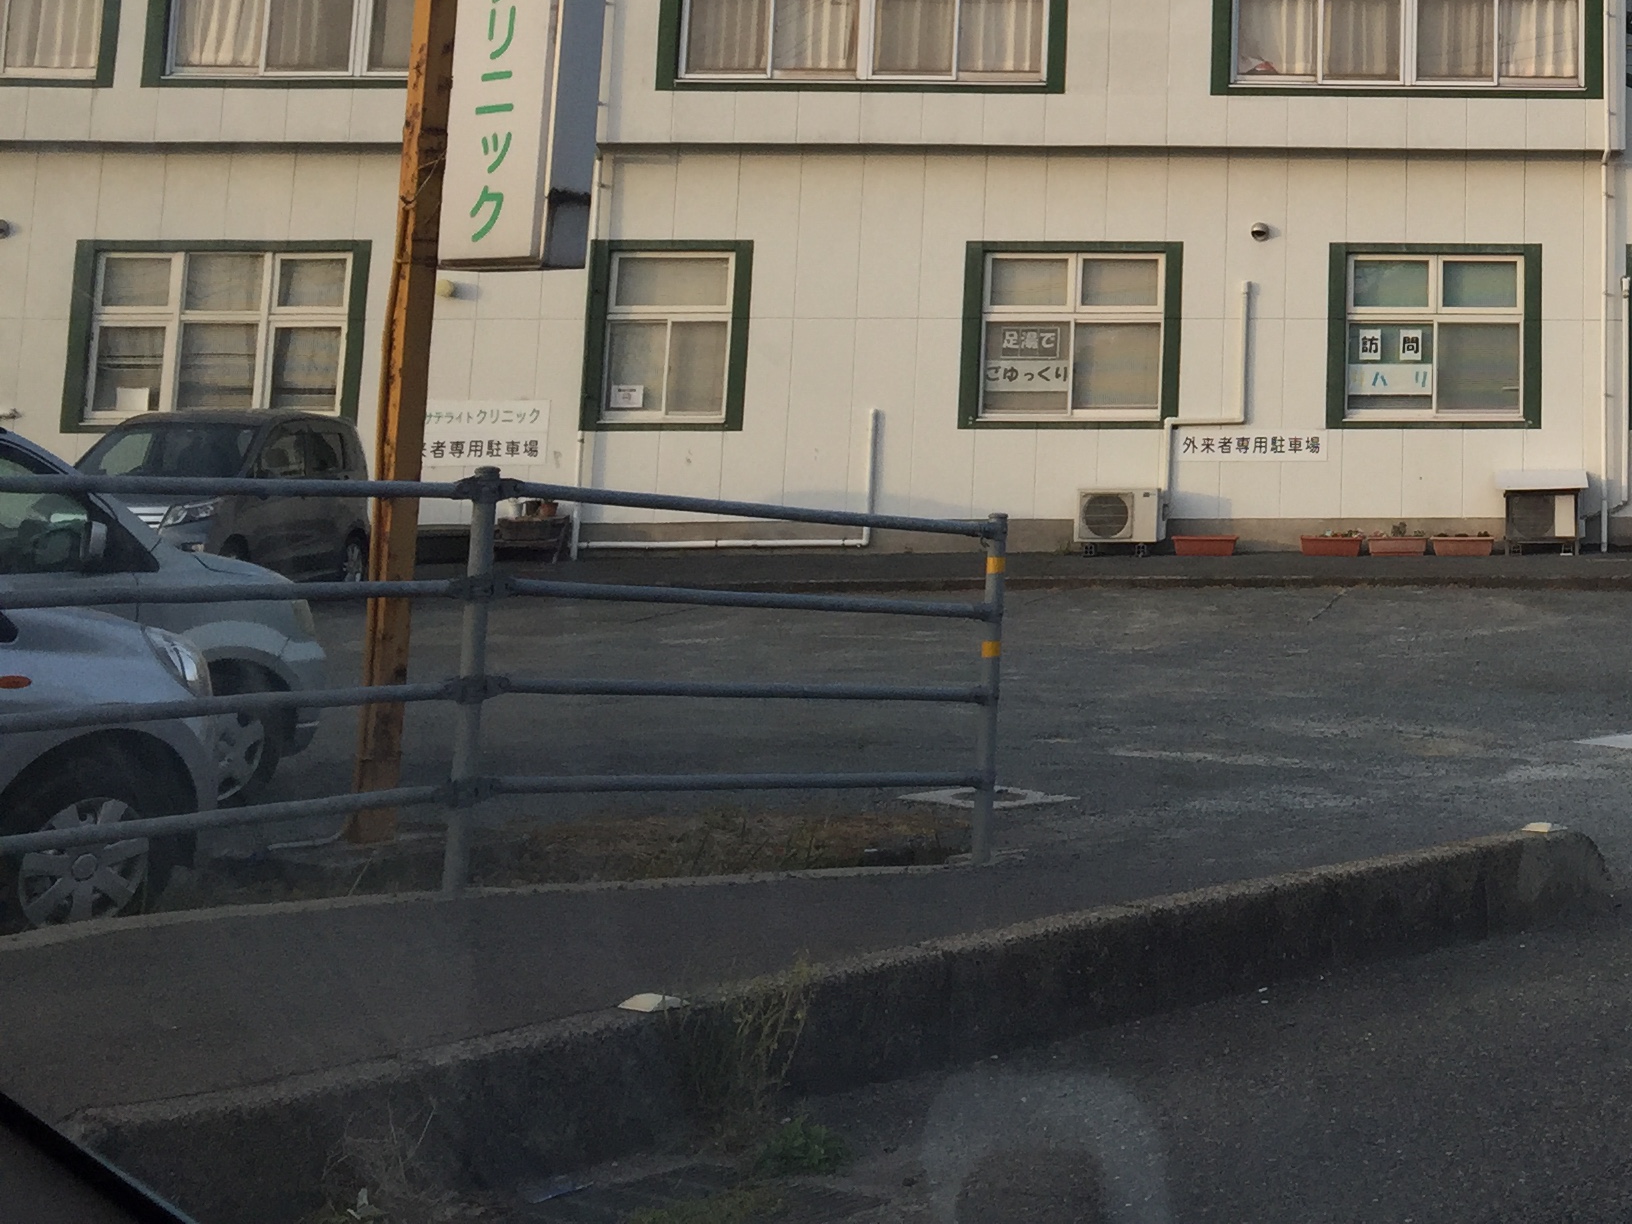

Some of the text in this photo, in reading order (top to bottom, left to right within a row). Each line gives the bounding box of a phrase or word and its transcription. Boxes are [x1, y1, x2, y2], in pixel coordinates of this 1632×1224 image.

[986, 366, 1067, 382] ごゆっくり
[1182, 436, 1321, 454] 外来者専用駐車場
